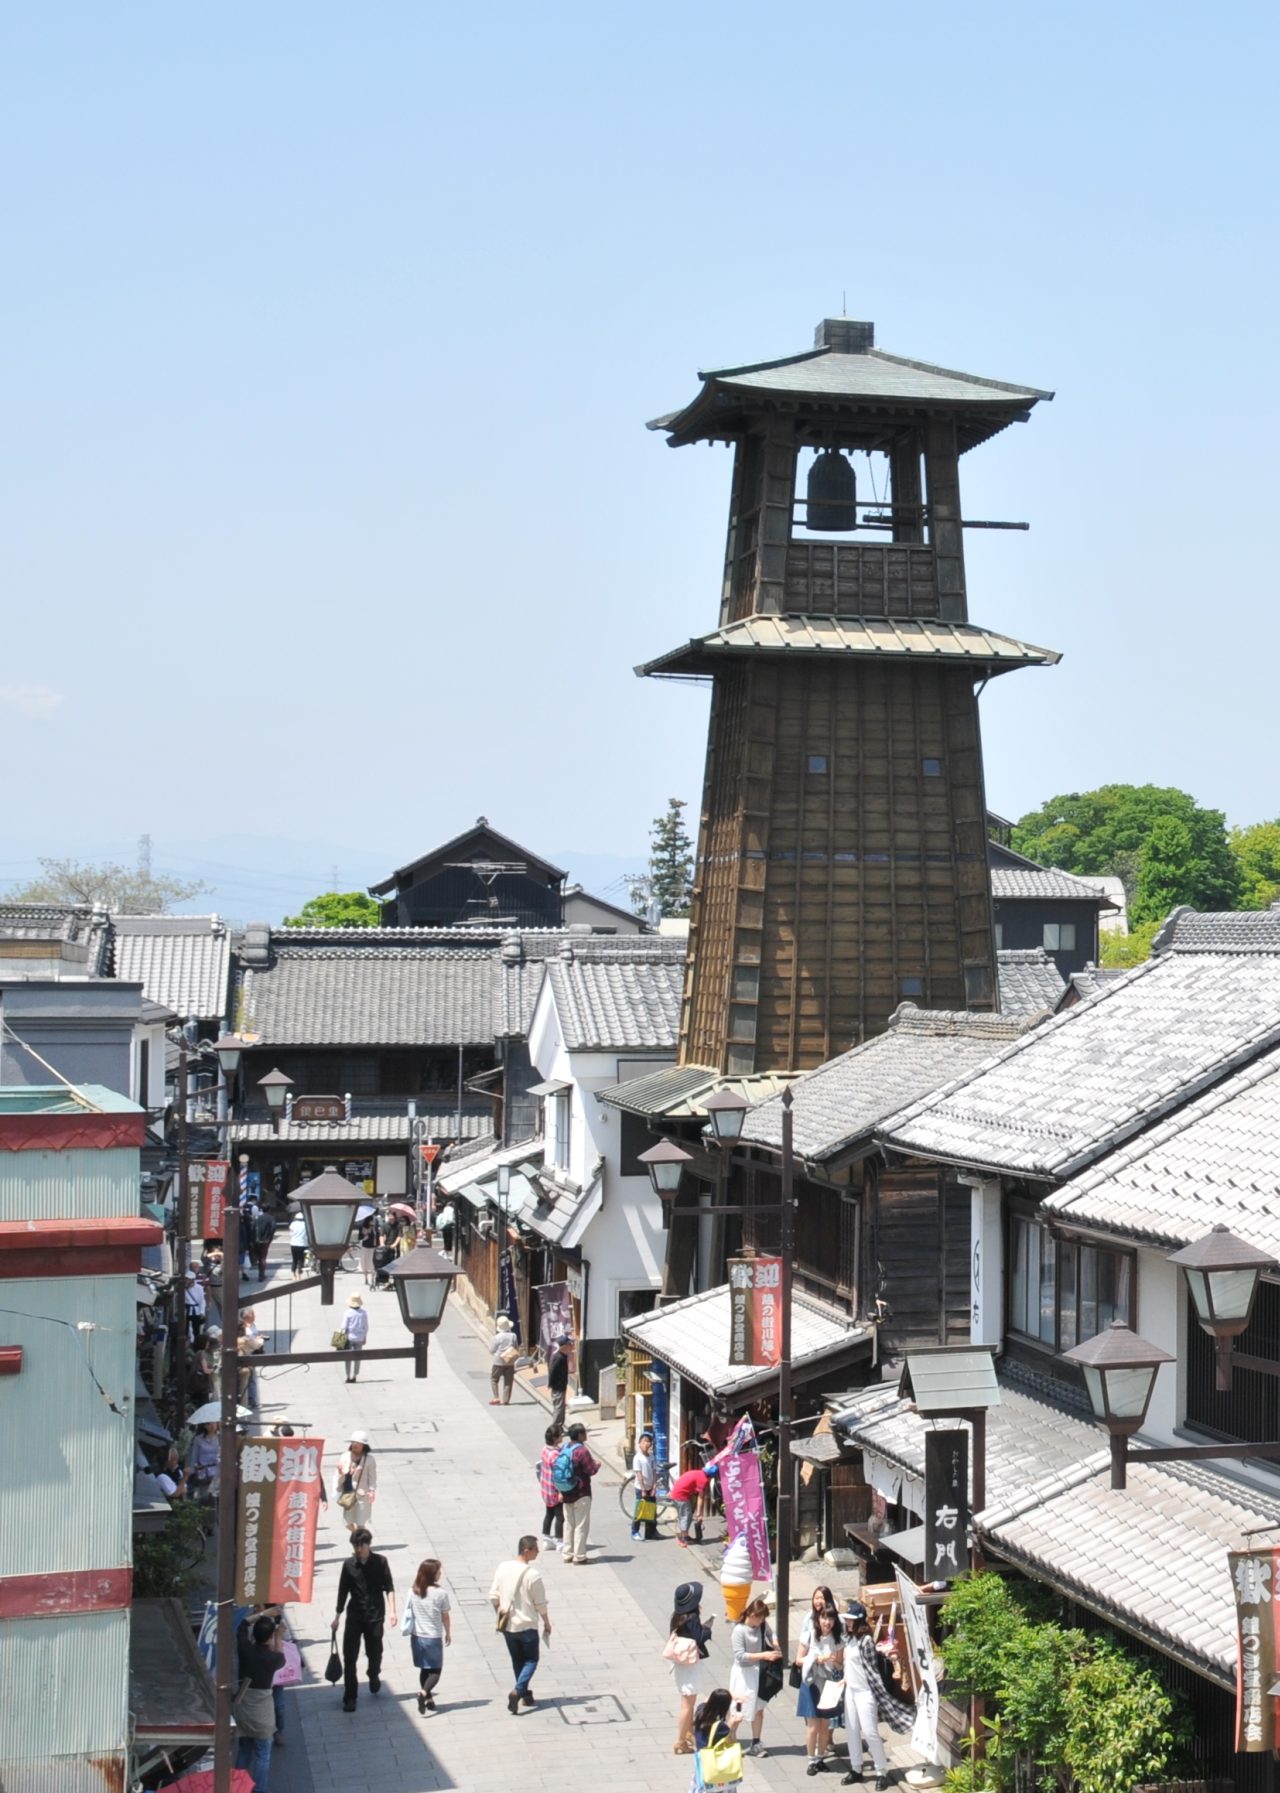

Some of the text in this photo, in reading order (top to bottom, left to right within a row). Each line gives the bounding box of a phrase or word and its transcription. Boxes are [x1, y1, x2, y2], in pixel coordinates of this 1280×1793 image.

[188, 1164, 226, 1182] 歓迎
[731, 1264, 780, 1288] 歓迎
[240, 1445, 319, 1483] 歓迎
[934, 1504, 959, 1567] 右門
